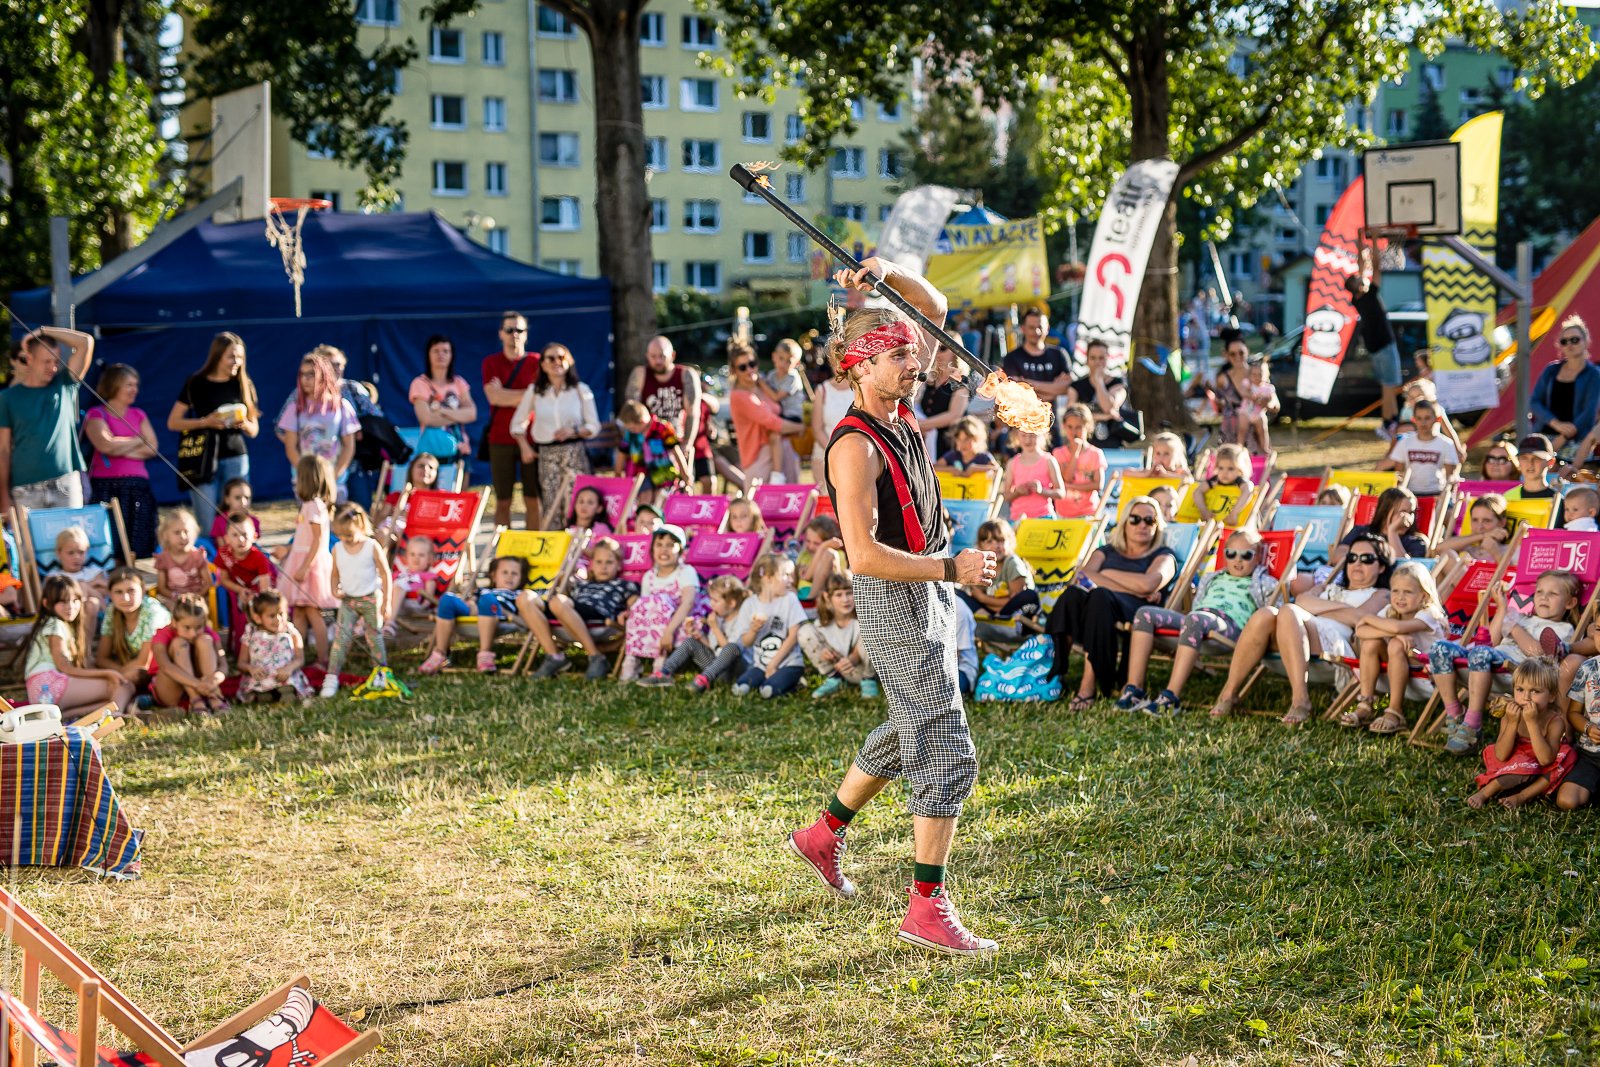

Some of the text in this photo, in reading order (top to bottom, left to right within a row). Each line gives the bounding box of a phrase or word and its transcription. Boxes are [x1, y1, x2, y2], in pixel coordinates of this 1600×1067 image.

[1106, 179, 1142, 243] teatr
[1046, 529, 1071, 550] JCK
[1558, 542, 1588, 572] JCK
